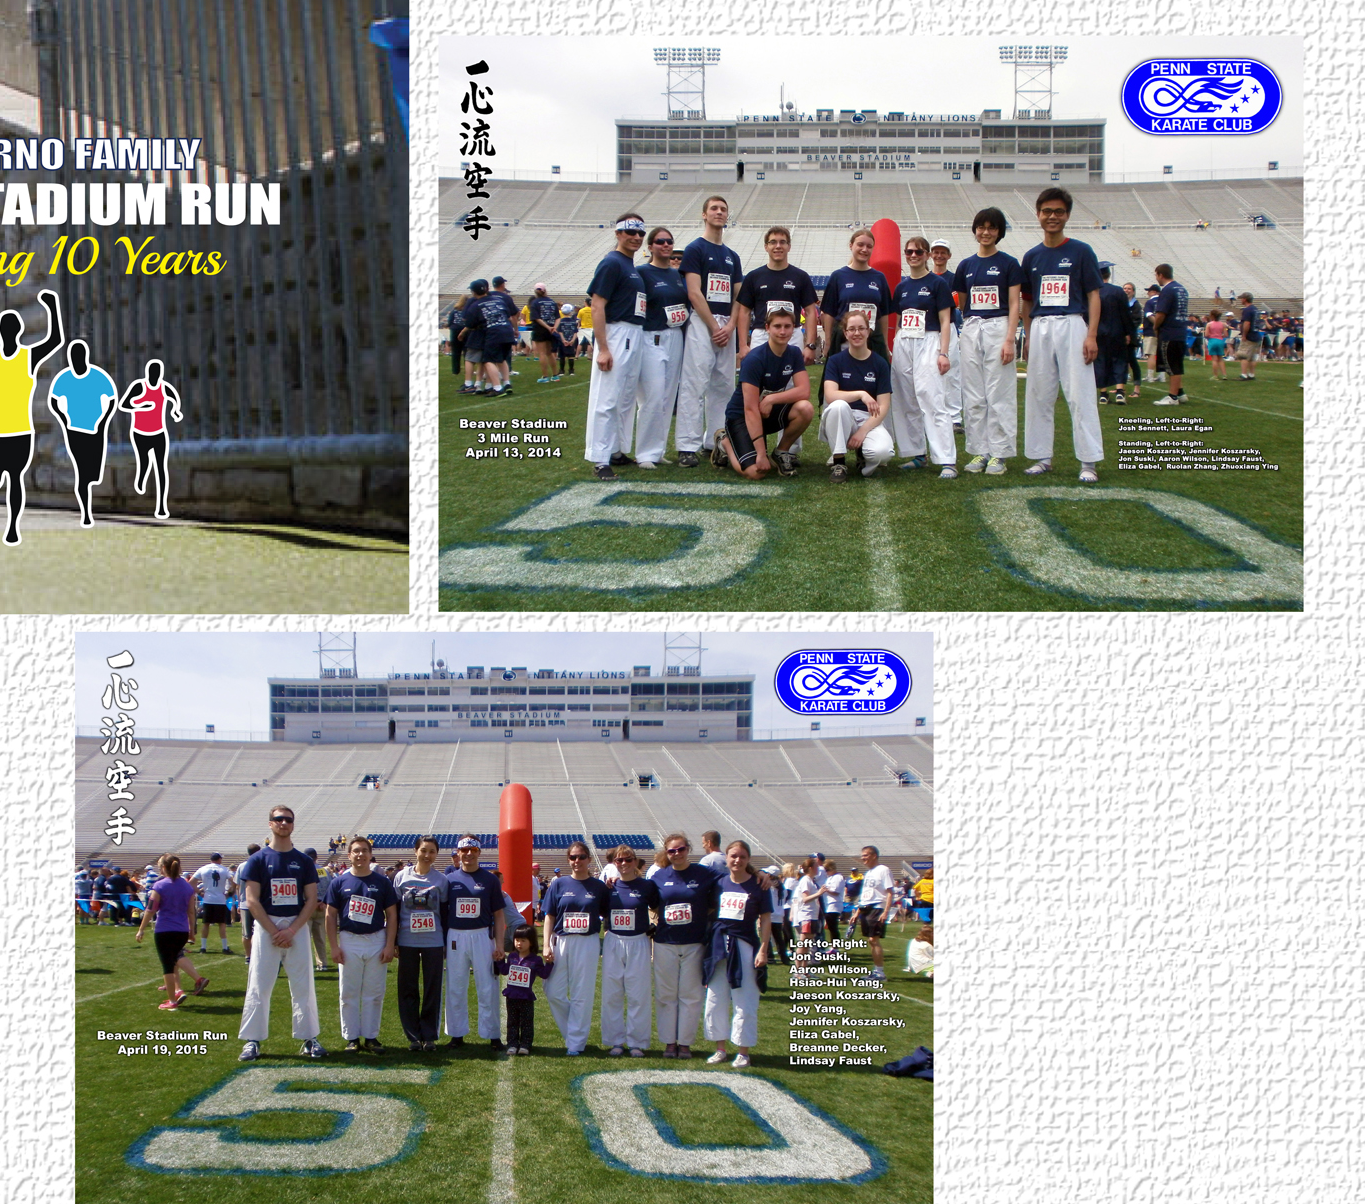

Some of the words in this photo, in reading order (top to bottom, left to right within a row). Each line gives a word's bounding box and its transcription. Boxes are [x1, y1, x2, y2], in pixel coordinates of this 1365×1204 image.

[709, 279, 730, 292] 1768
[1041, 282, 1067, 295] 1964
[671, 310, 686, 322] 956
[272, 883, 297, 897] 3400
[460, 903, 477, 914] 999
[411, 917, 434, 929] 2548
